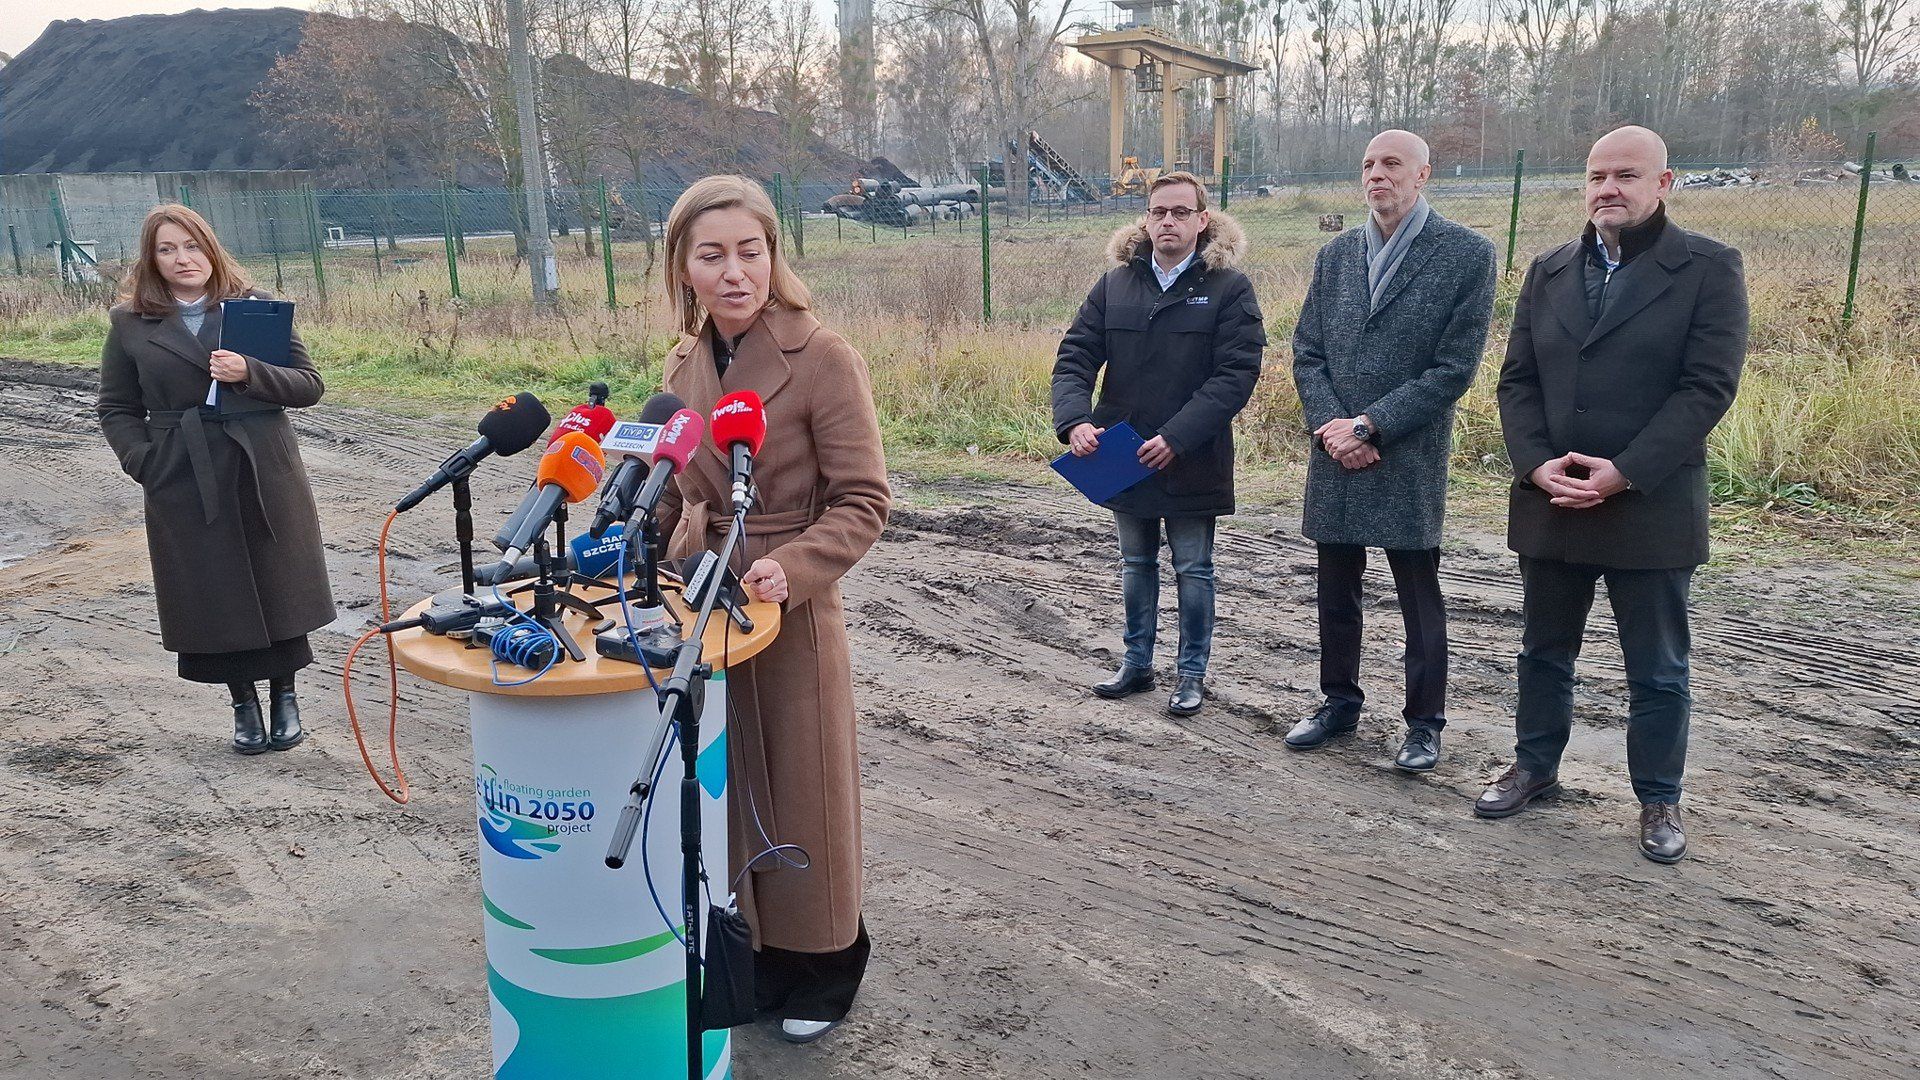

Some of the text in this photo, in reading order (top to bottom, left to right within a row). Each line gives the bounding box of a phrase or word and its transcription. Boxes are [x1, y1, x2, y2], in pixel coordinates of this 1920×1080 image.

[713, 400, 745, 421] Twoje
[613, 441, 644, 449] SZCZECIN
[503, 778, 591, 800] floating garden
[528, 799, 595, 821] 2050
[547, 823, 592, 836] project
